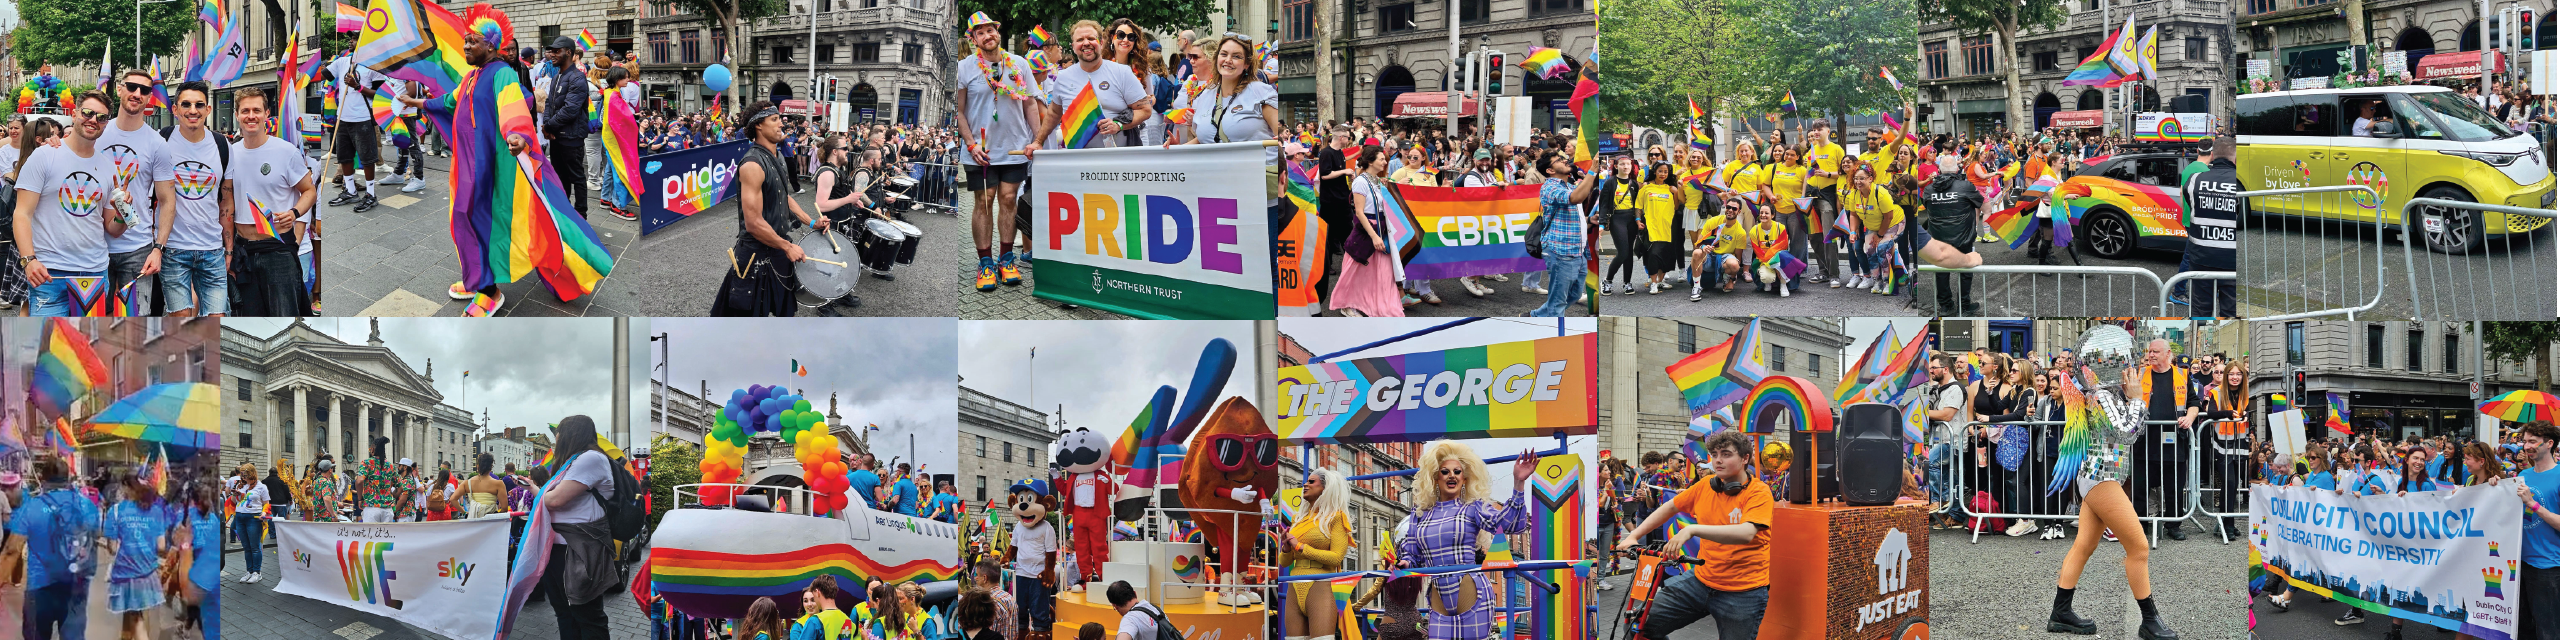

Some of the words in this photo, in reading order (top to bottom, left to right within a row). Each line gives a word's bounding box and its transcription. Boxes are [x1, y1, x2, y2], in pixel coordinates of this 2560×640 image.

[2425, 63, 2482, 77] Newsweek
[2056, 118, 2095, 126] Newsweek
[1080, 172, 1119, 182] PROUDLY
[1122, 172, 1186, 183] SUPPORTING
[2264, 166, 2294, 177] Driven
[663, 159, 726, 209] pride
[2199, 181, 2236, 193] PULSE
[2265, 178, 2277, 190] by
[2279, 178, 2300, 189] love
[680, 195, 700, 208] powers
[701, 185, 725, 199] innovation
[1931, 192, 1958, 201] PULSE
[2199, 196, 2214, 209] TEAM
[2215, 197, 2236, 212] LEADER
[2132, 205, 2153, 213] BRÓD
[1048, 191, 1243, 275] PRIDE
[1437, 213, 1530, 247] CBRE
[2142, 226, 2164, 235] DAVIS
[1106, 279, 1152, 295] NORTHERN
[1153, 287, 1183, 300] TRUST
[1287, 379, 1357, 417] THE
[1366, 359, 1568, 412] GEORGE
[2270, 497, 2310, 524] DUBLIN
[2312, 502, 2360, 532] CITY
[2363, 507, 2484, 540] COUNCIL
[337, 527, 349, 537] it's
[352, 529, 366, 537] not
[2277, 523, 2352, 555] CELEBRATING
[2357, 540, 2445, 566] DIVERSITY
[293, 549, 311, 568] sky
[336, 540, 403, 611] WE
[437, 557, 476, 587] sky
[1856, 596, 1895, 633] JUST
[1896, 589, 1922, 615] EAT
[2476, 600, 2494, 611] Dublin
[2495, 604, 2506, 615] City
[2473, 612, 2493, 622] LGBT+
[2494, 616, 2508, 626] Staff
